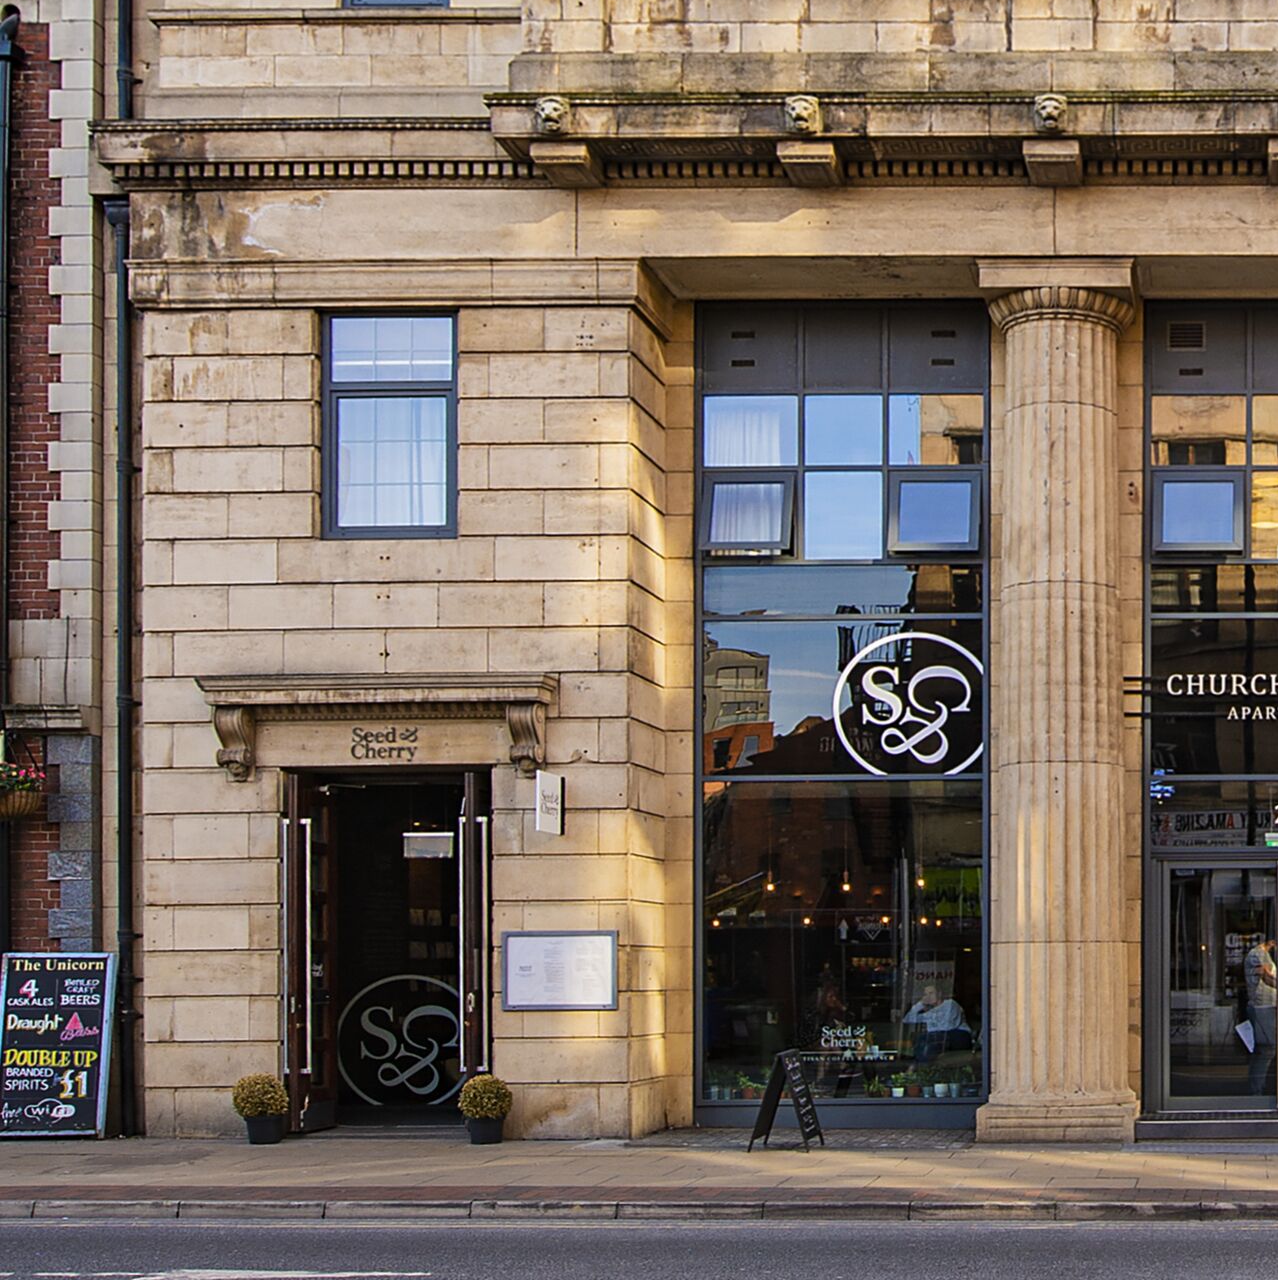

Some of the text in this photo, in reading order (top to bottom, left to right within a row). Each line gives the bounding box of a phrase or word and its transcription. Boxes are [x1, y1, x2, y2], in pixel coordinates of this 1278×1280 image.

[352, 725, 418, 743] Seed &
[350, 743, 418, 762] Cherry
[13, 959, 104, 971] The Unicorn
[19, 979, 39, 998] 4
[7, 997, 54, 1006] CASK ALES
[60, 994, 100, 1005] BEERS
[7, 1013, 64, 1035] Draught
[3, 1049, 98, 1067] DOUBLE UP
[6, 1067, 54, 1077] BRANDED
[4, 1078, 49, 1091] SPIRITS
